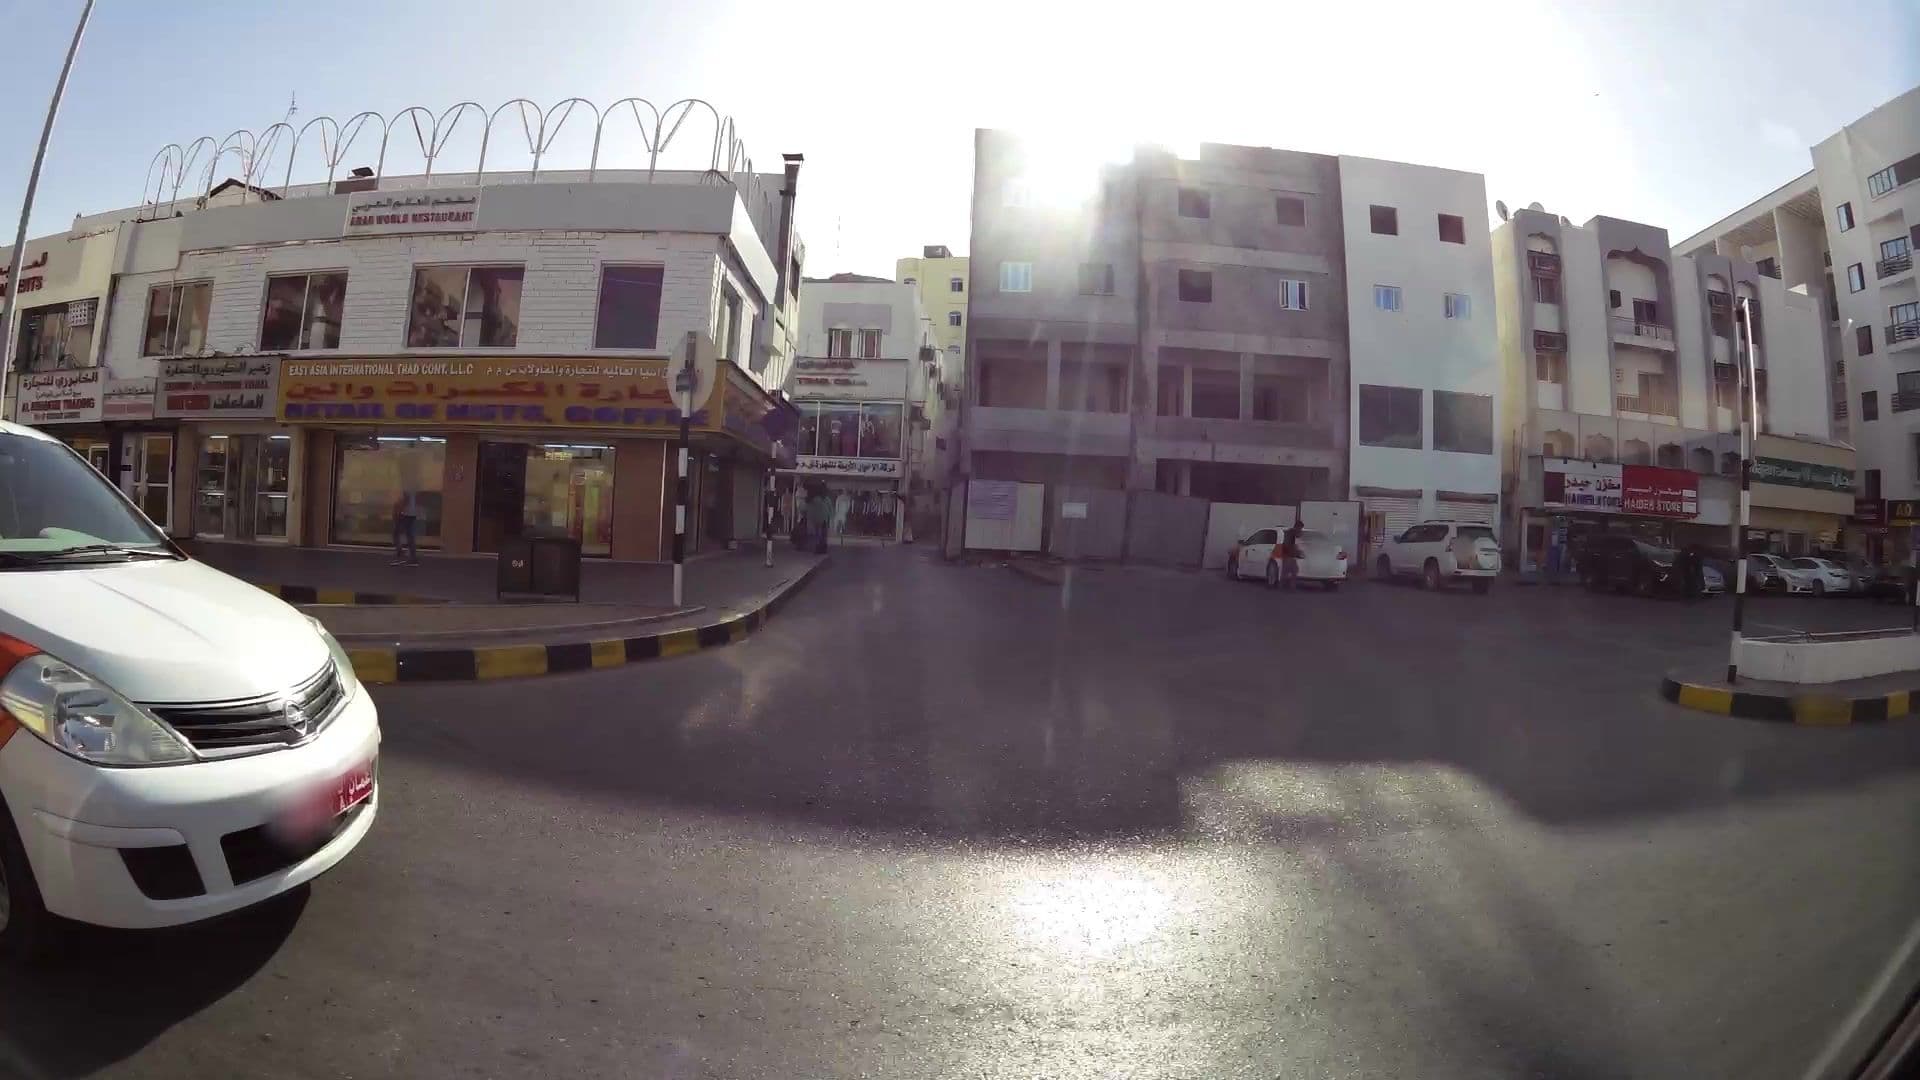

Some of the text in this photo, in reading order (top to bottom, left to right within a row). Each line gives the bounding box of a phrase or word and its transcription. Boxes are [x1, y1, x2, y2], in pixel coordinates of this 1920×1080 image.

[350, 211, 474, 226] ARAB WORLD RESTAURANT
[288, 365, 308, 376] EAST
[309, 364, 329, 376] ASIA
[330, 364, 395, 375] INTERNATIONAL
[1655, 501, 1682, 513] STORE
